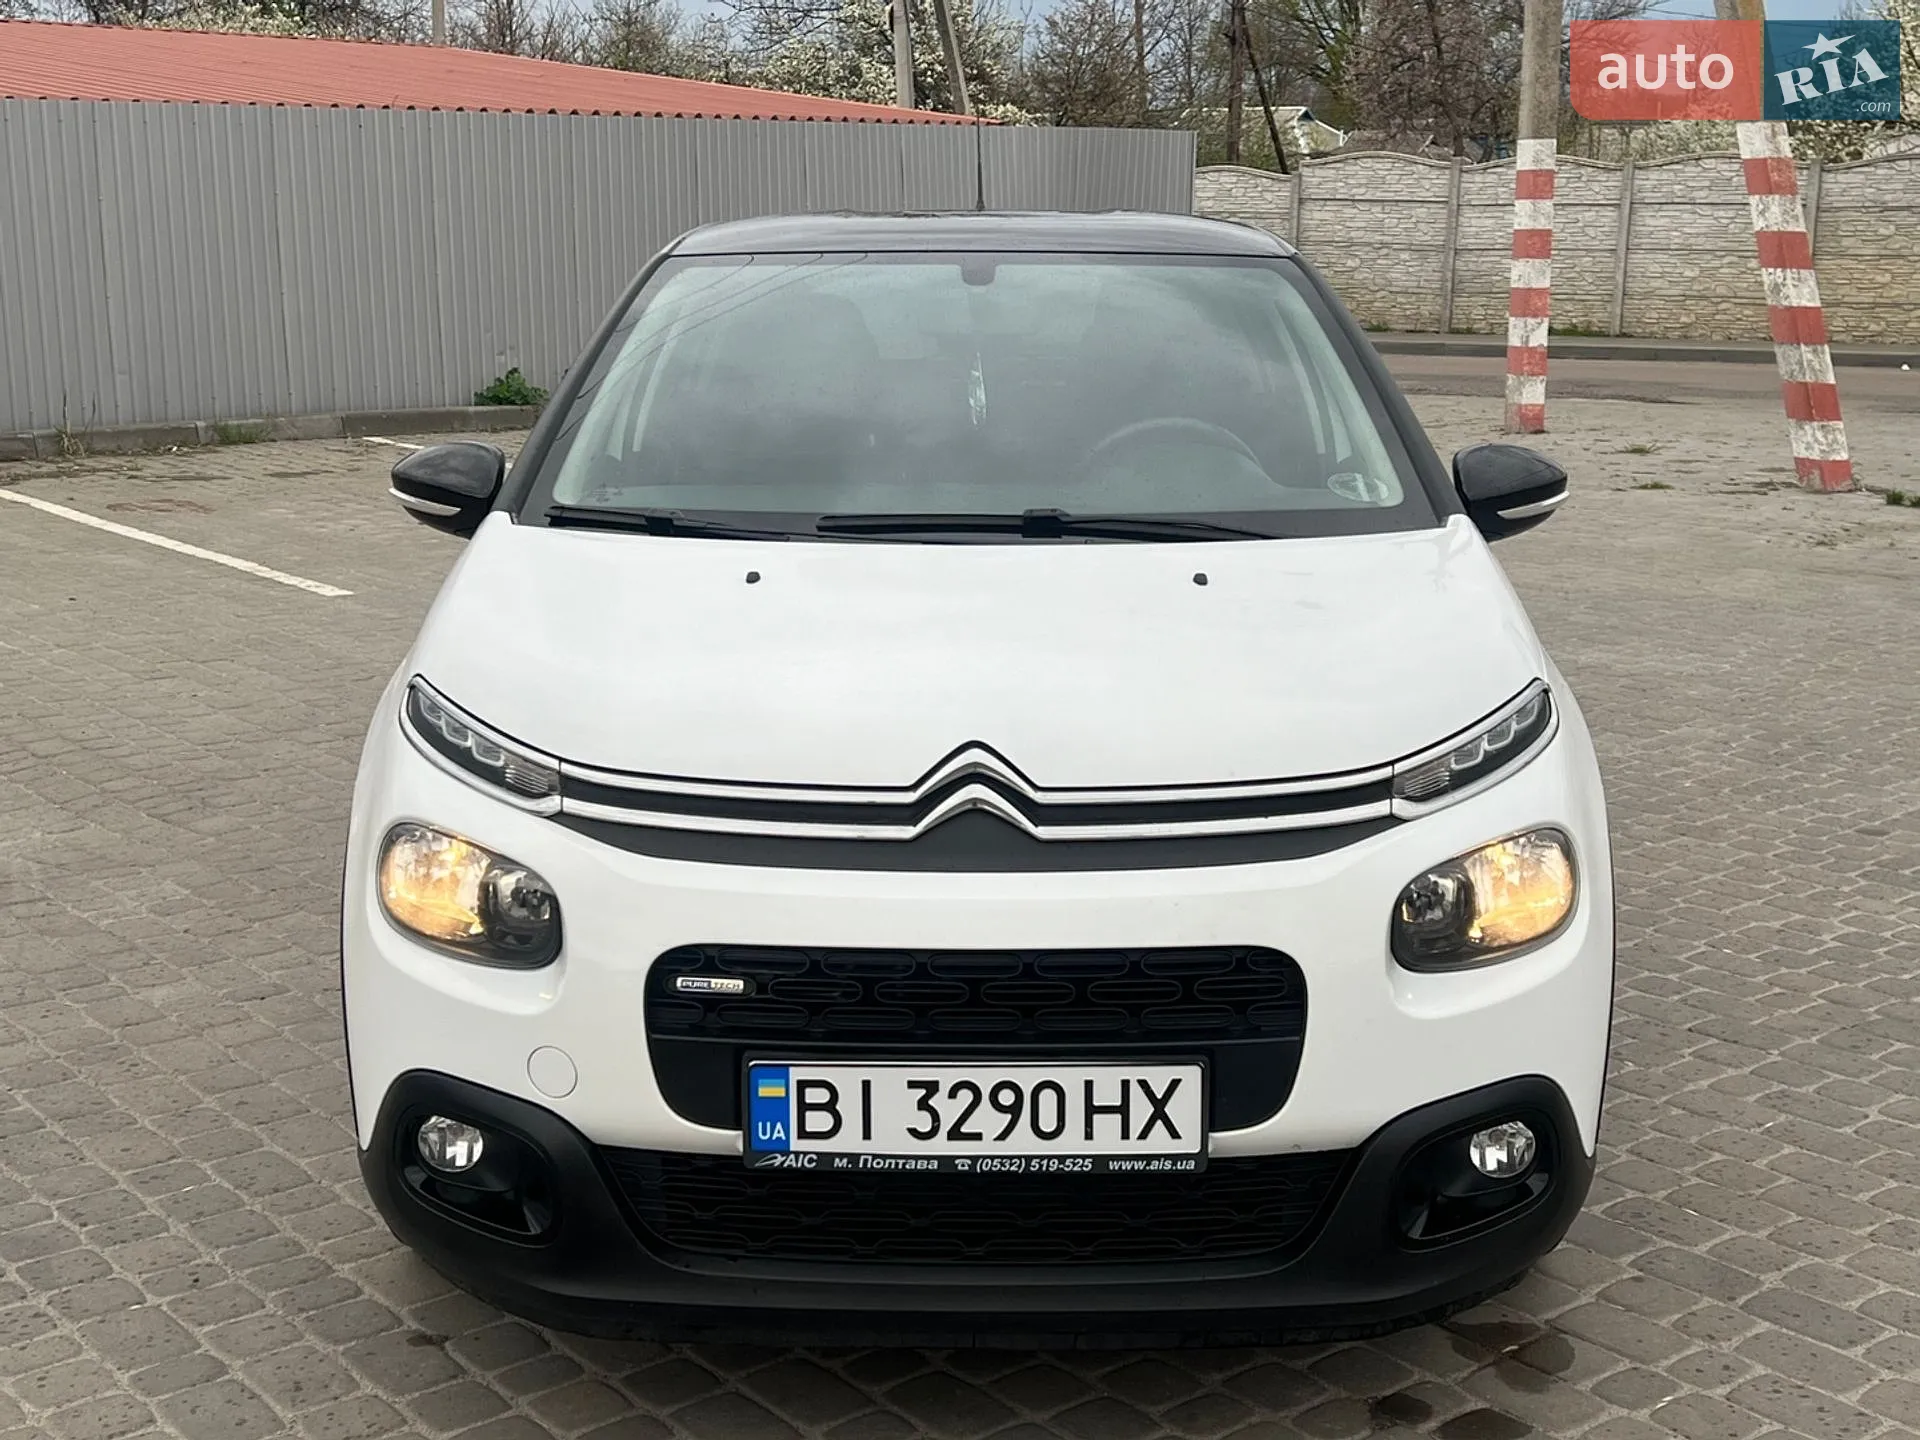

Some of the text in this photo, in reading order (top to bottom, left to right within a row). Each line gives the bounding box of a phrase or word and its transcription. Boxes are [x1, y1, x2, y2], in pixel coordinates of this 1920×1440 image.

[796, 1078, 1183, 1141] BI 3290 HX
[758, 1121, 786, 1140] UA
[858, 1155, 939, 1170] Полтава
[976, 1158, 1093, 1173] (0532) 519-525
[1108, 1157, 1196, 1171] www.ais.ua
